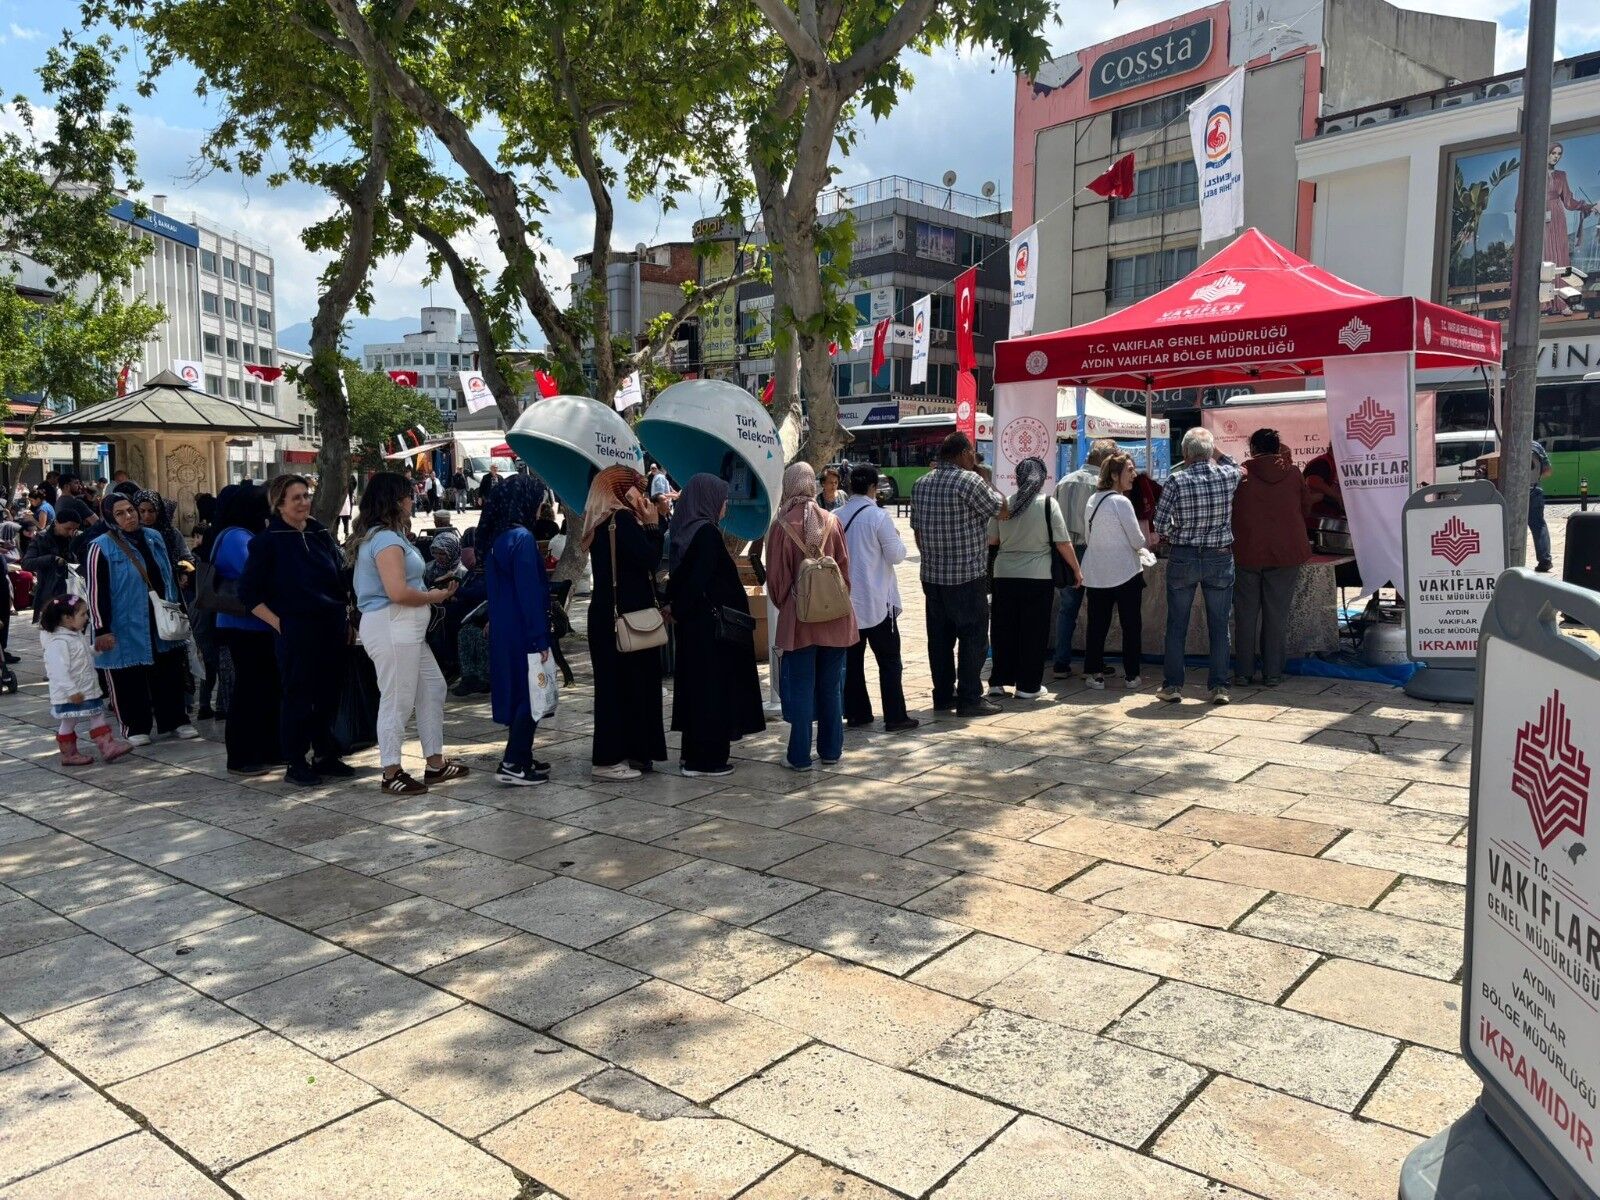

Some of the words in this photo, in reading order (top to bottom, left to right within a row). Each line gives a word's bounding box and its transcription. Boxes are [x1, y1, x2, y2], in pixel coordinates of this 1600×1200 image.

[1101, 36, 1192, 84] cossta
[1088, 344, 1108, 354] T.C.
[1112, 338, 1164, 352] VAKIFLAR
[1167, 335, 1206, 348] GENEL
[1209, 325, 1288, 345] MÜDÜRLÜĞÜ
[1081, 357, 1114, 370] AYDIN
[1118, 353, 1169, 367] VAKIFLAR
[1173, 346, 1213, 363] BÖLGE
[1216, 340, 1295, 360] MÜDÜRLÜĞÜ
[735, 414, 757, 428] Türk
[595, 432, 617, 445] Türk
[737, 428, 775, 446] Telekom
[595, 445, 634, 461] Telekom
[1419, 577, 1495, 592] VAKIFLAR
[1419, 626, 1446, 635] BÖLGE
[1447, 625, 1480, 634] MÜDÜRL
[1533, 856, 1550, 883] T.C.
[1488, 847, 1600, 972] VAKIFLAR
[1487, 892, 1521, 932] GENEL
[1525, 921, 1600, 1000] MÜDÜRLÜĞÜ
[1522, 967, 1556, 1008] AYDIN
[1511, 981, 1566, 1048] VAKIFLAR
[1481, 981, 1520, 1028] BÖLGE
[1522, 1018, 1597, 1109] MÜDÜRLÜĞÜ
